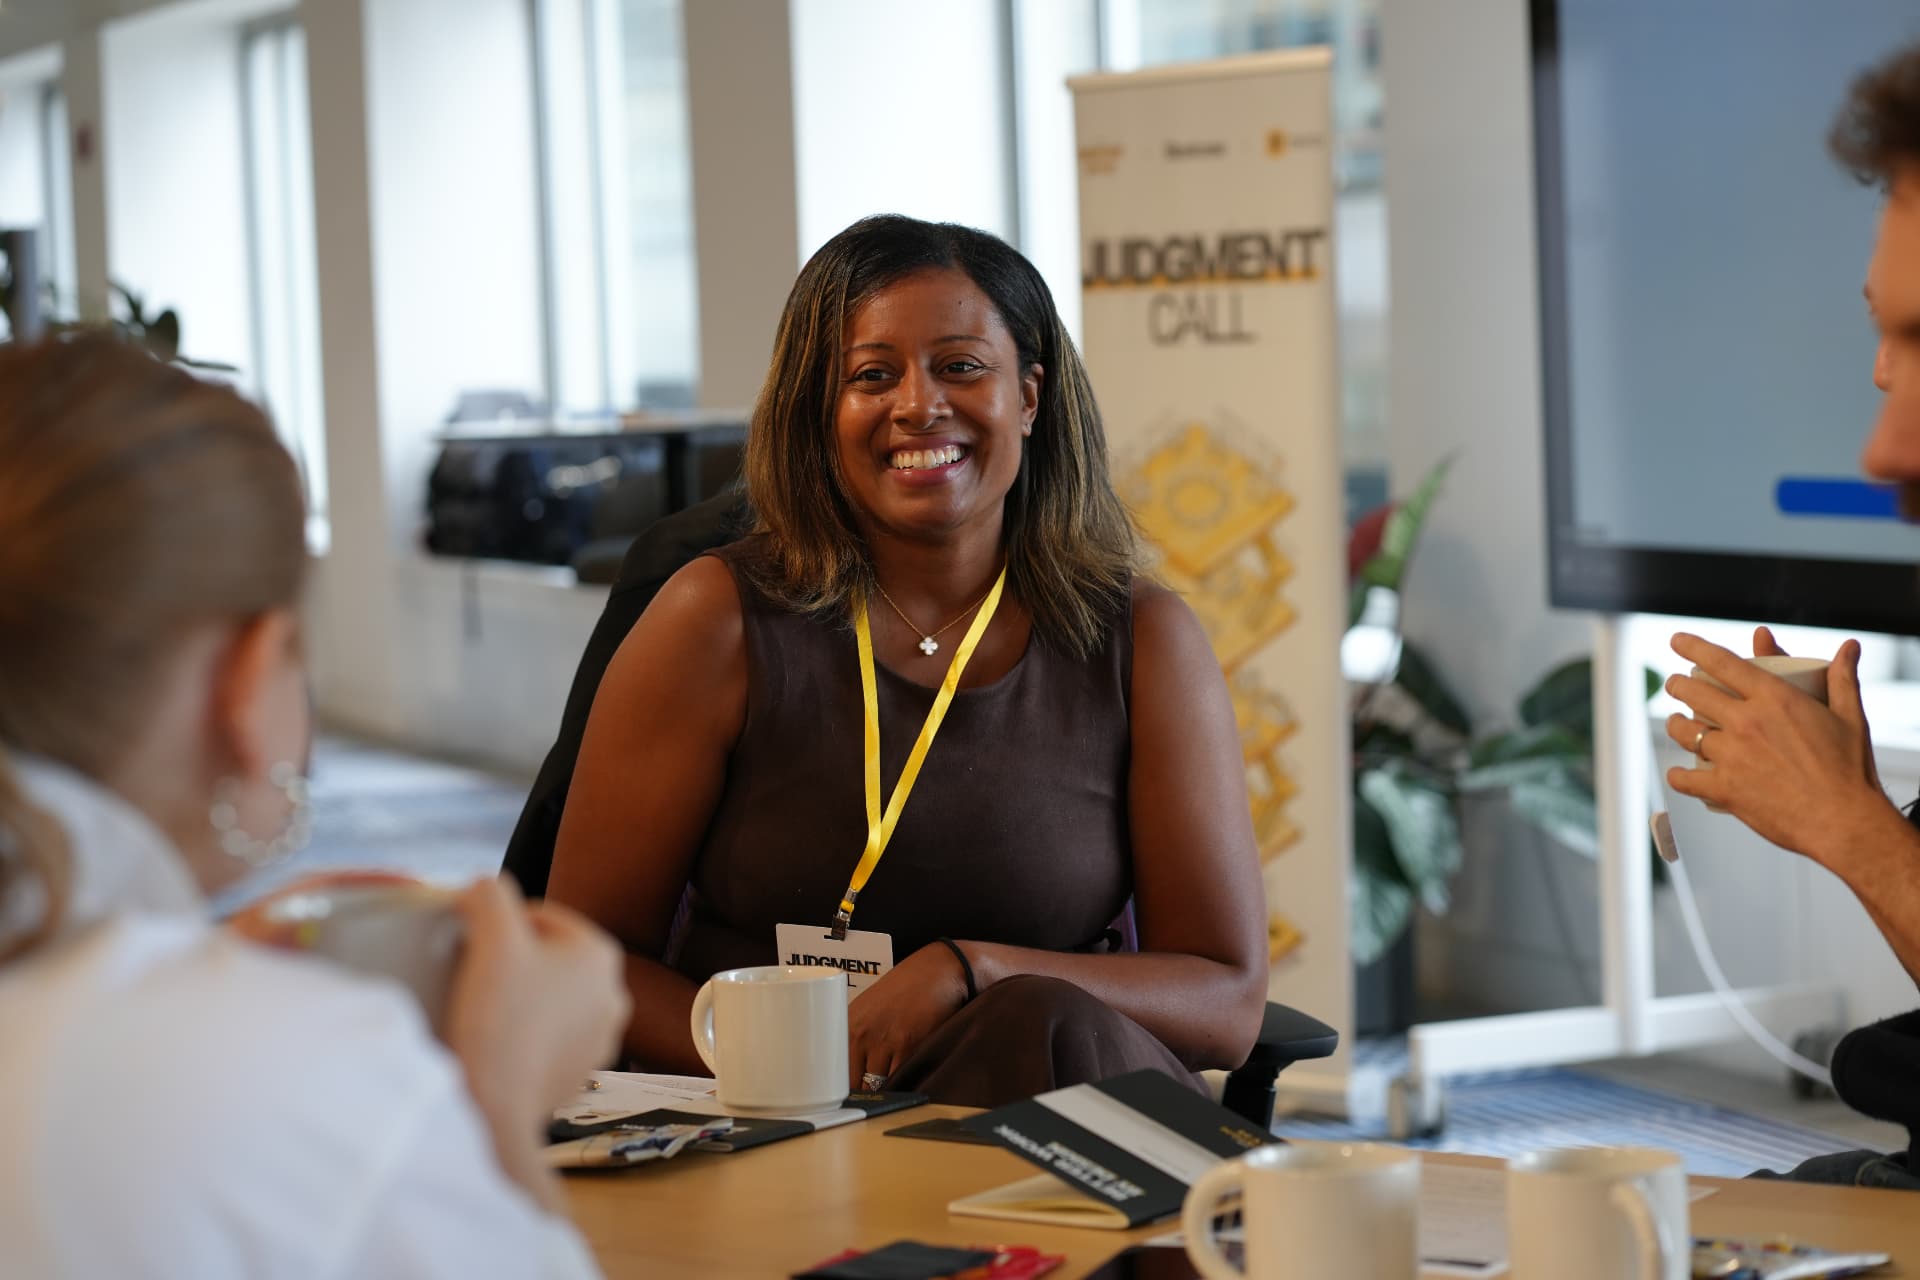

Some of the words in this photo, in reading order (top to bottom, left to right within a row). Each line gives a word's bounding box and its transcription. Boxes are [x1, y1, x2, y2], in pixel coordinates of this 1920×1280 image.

[1083, 227, 1326, 286] JUDGMENT
[1149, 292, 1257, 345] CALL
[786, 953, 881, 976] JUDGMENT
